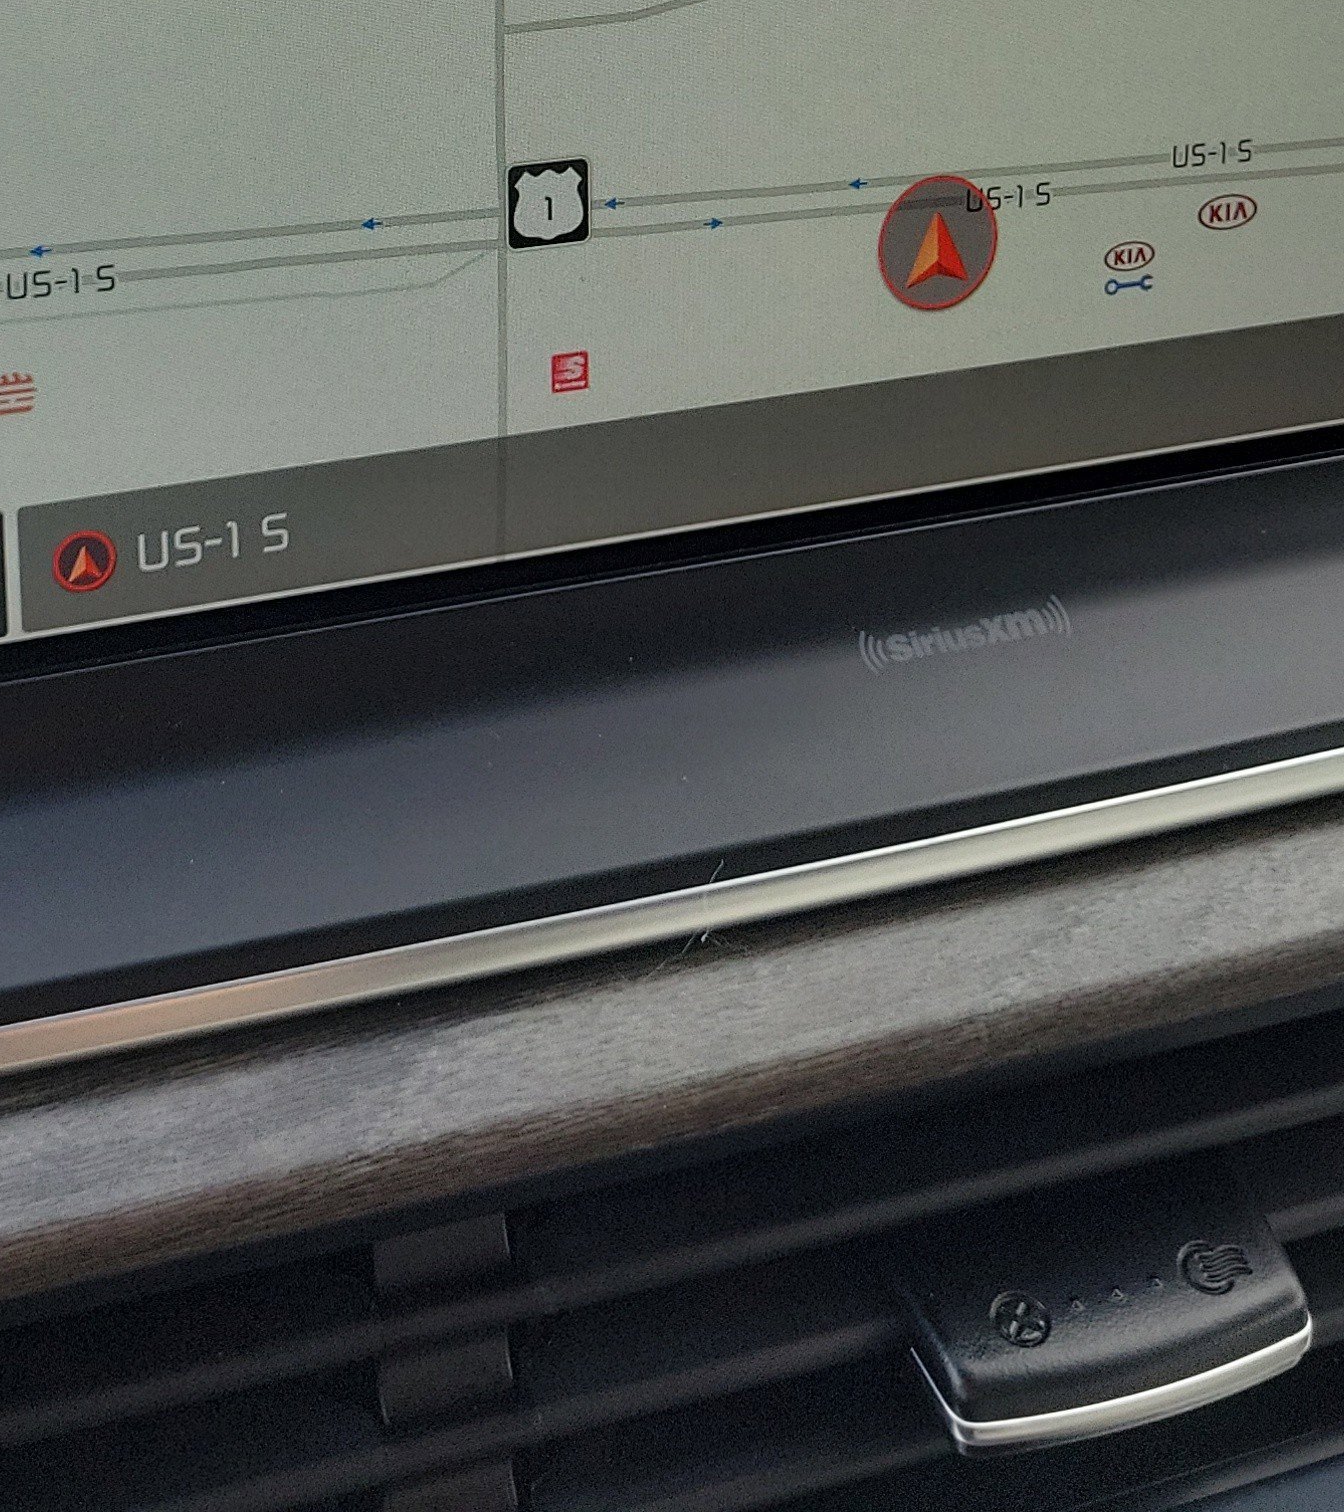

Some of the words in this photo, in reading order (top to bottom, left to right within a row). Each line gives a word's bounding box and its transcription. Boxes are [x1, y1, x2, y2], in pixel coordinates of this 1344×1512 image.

[1172, 143, 1227, 168] US-1
[1237, 139, 1253, 163] S
[542, 194, 555, 224] 1
[964, 186, 1024, 213] US-1
[1035, 182, 1052, 206] S
[1208, 202, 1249, 223] KIA
[1113, 248, 1147, 265] KIA
[4, 269, 85, 300] US-1
[95, 265, 117, 294] S
[136, 523, 242, 574] US-1
[260, 514, 291, 553] S
